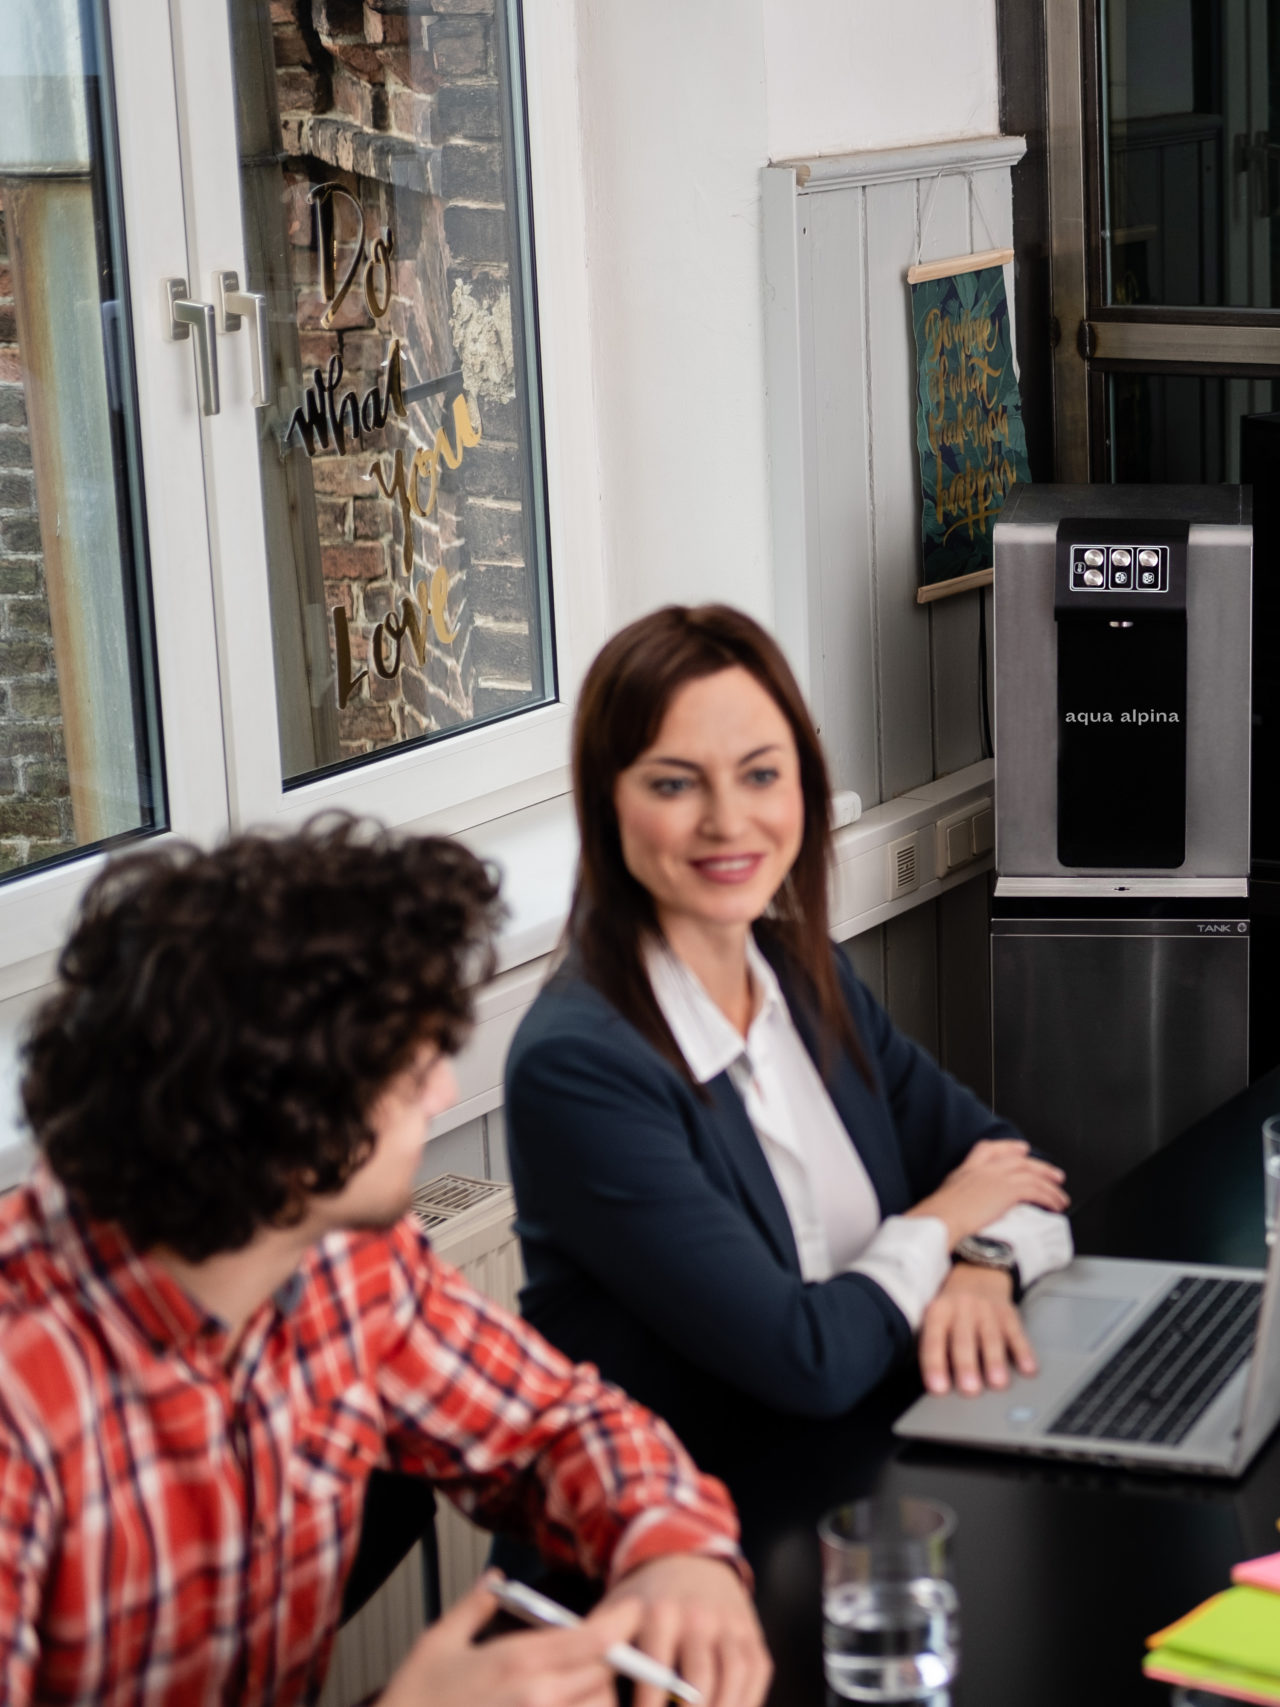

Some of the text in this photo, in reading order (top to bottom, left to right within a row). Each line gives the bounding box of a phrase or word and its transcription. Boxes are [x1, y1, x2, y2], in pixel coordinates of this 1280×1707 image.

[306, 181, 395, 329] Do
[1065, 708, 1180, 726] aqua alpina
[1196, 924, 1231, 933] TANK
